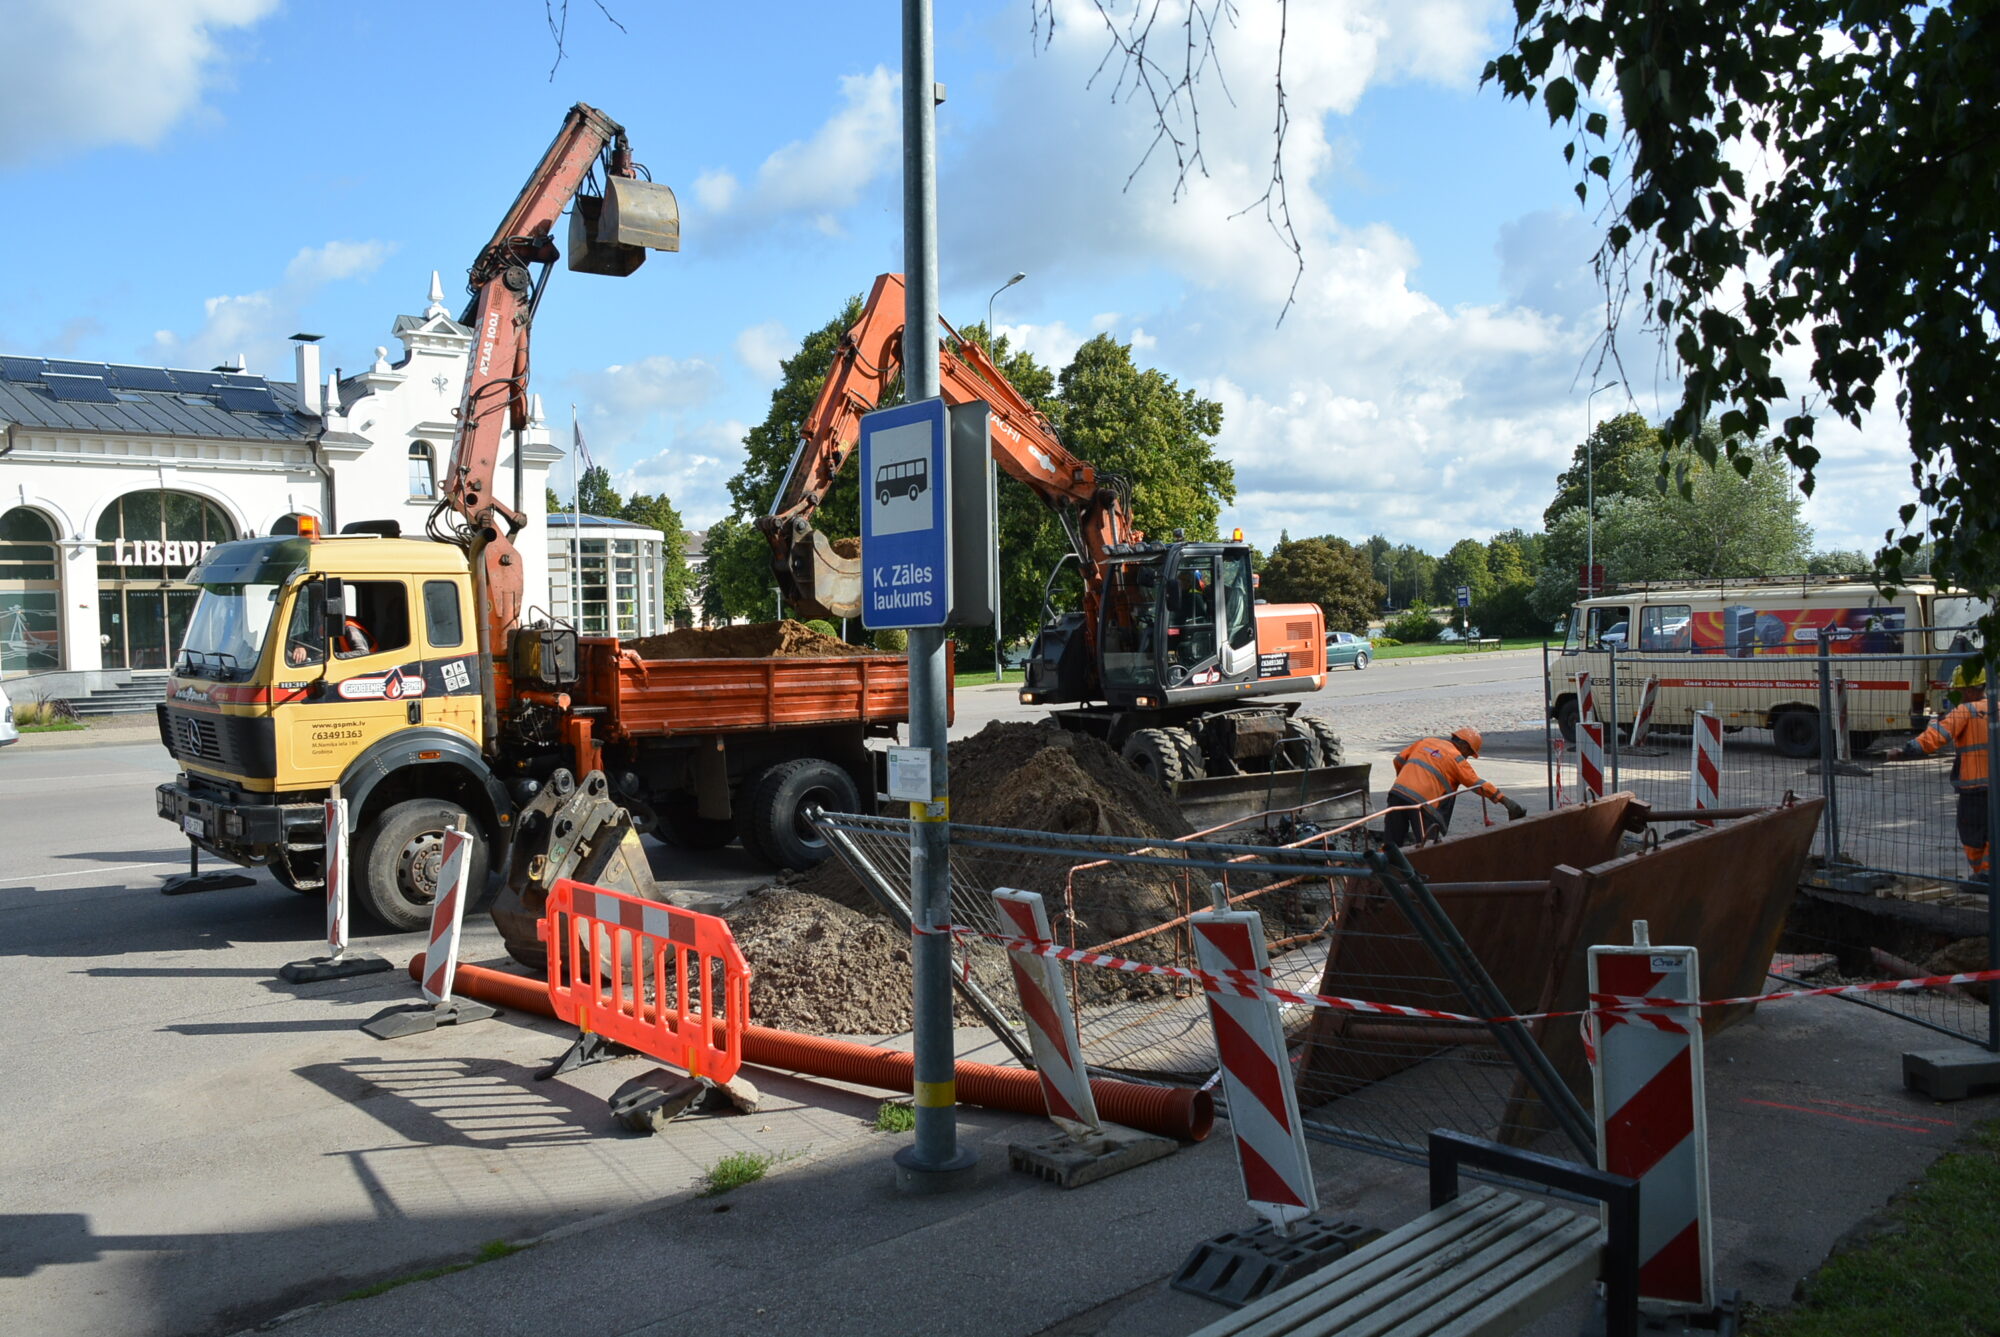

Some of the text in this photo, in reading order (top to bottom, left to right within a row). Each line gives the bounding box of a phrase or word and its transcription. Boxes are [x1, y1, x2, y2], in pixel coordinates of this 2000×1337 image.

[479, 340, 494, 377] ATLAS
[873, 563, 933, 588] K. Zāles
[874, 589, 933, 610] laukums
[312, 721, 366, 729] www.gspmk.lv
[316, 730, 363, 740] 63491363
